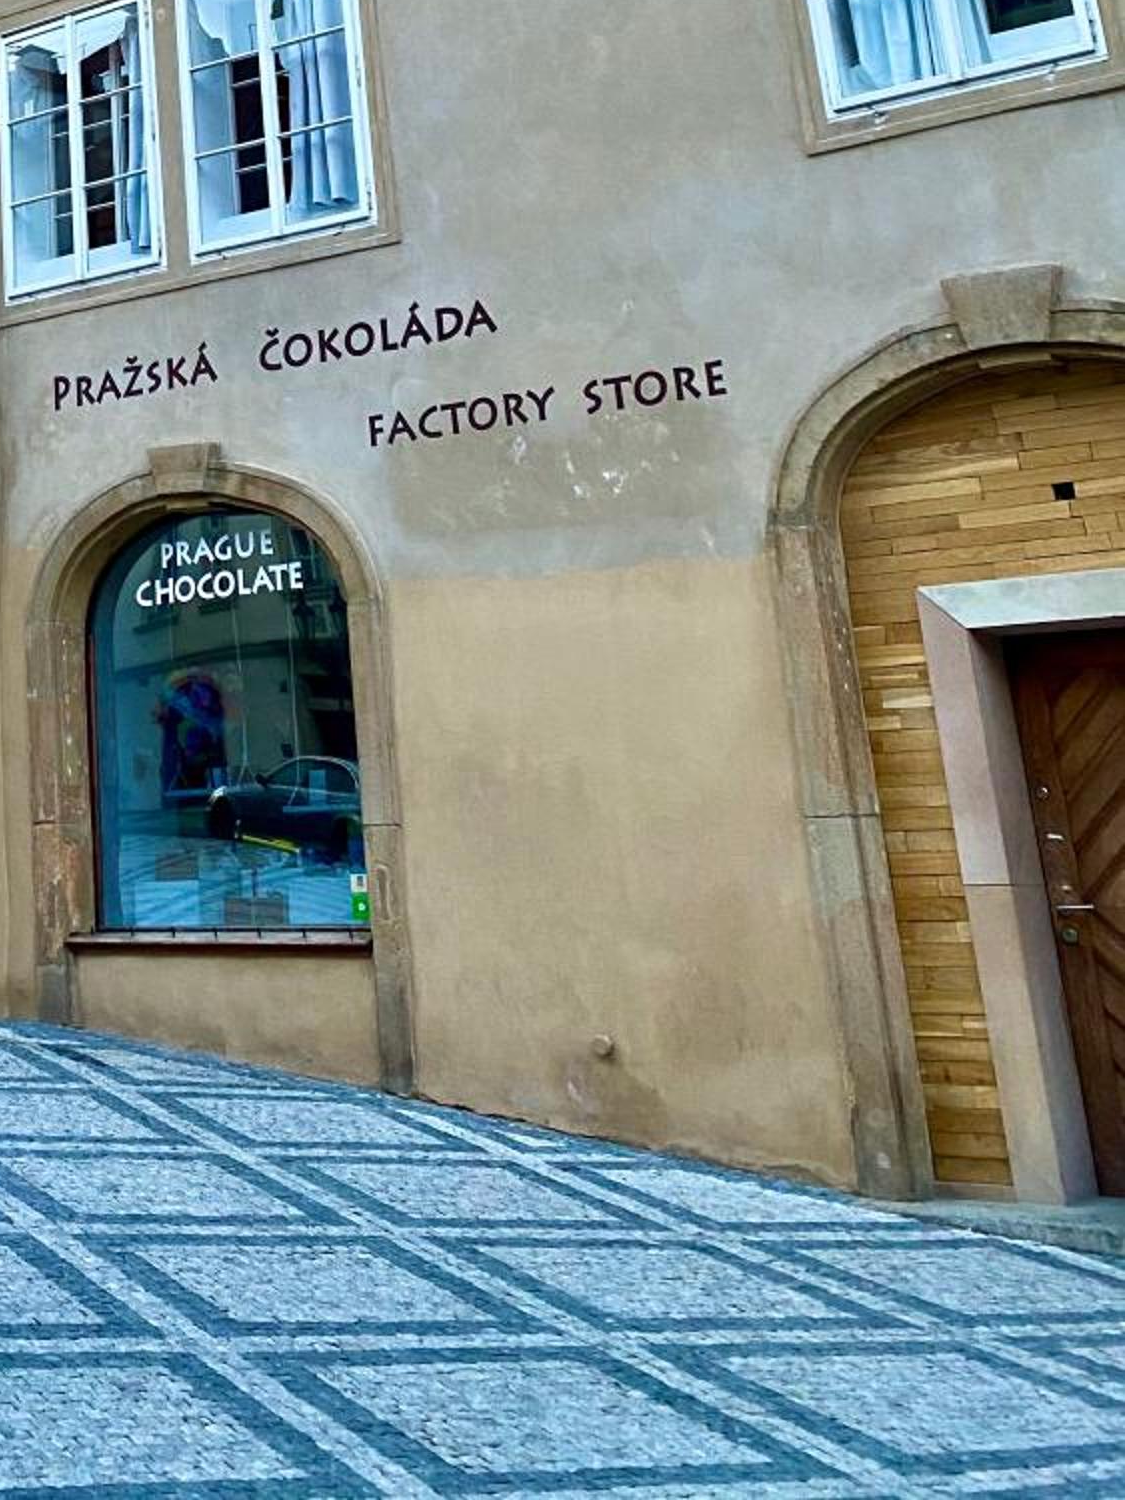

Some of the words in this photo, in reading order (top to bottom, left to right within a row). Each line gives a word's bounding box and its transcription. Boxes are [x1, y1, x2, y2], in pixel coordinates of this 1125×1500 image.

[54, 341, 218, 411] PRAŽSKÁ
[259, 299, 498, 371] ČOKOLÁDA
[368, 386, 555, 447] FACTORY
[583, 359, 727, 415] STORE
[161, 530, 274, 569] PRAGUE
[135, 561, 304, 607] CHOCOLATE
